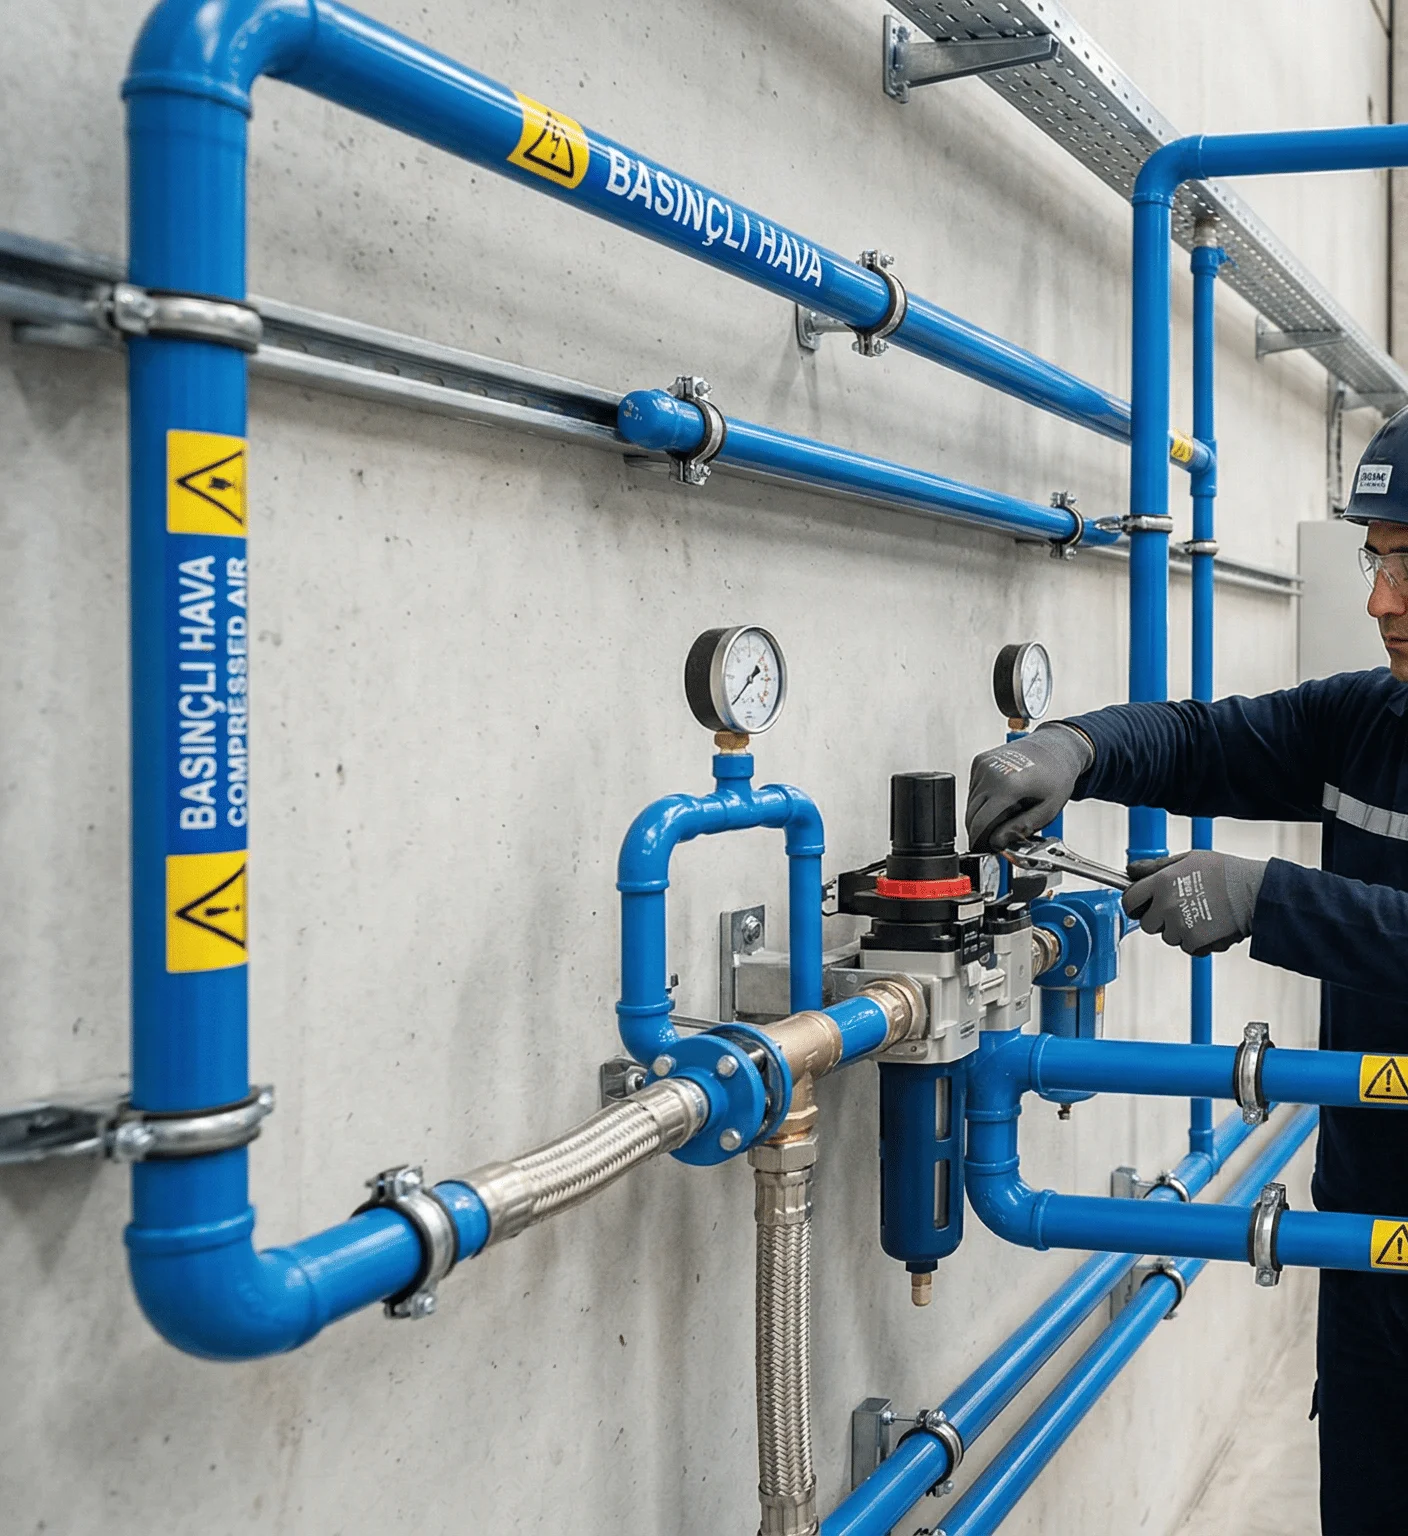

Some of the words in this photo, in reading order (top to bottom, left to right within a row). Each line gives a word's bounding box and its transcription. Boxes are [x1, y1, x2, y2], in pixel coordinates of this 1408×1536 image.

[605, 145, 750, 252] BASINÇLI
[756, 220, 823, 287] HAVA
[178, 555, 216, 651] HAVA
[226, 557, 247, 609] AIR
[178, 661, 226, 830] BASINÇLI
[227, 615, 247, 828] COMPRESSED
